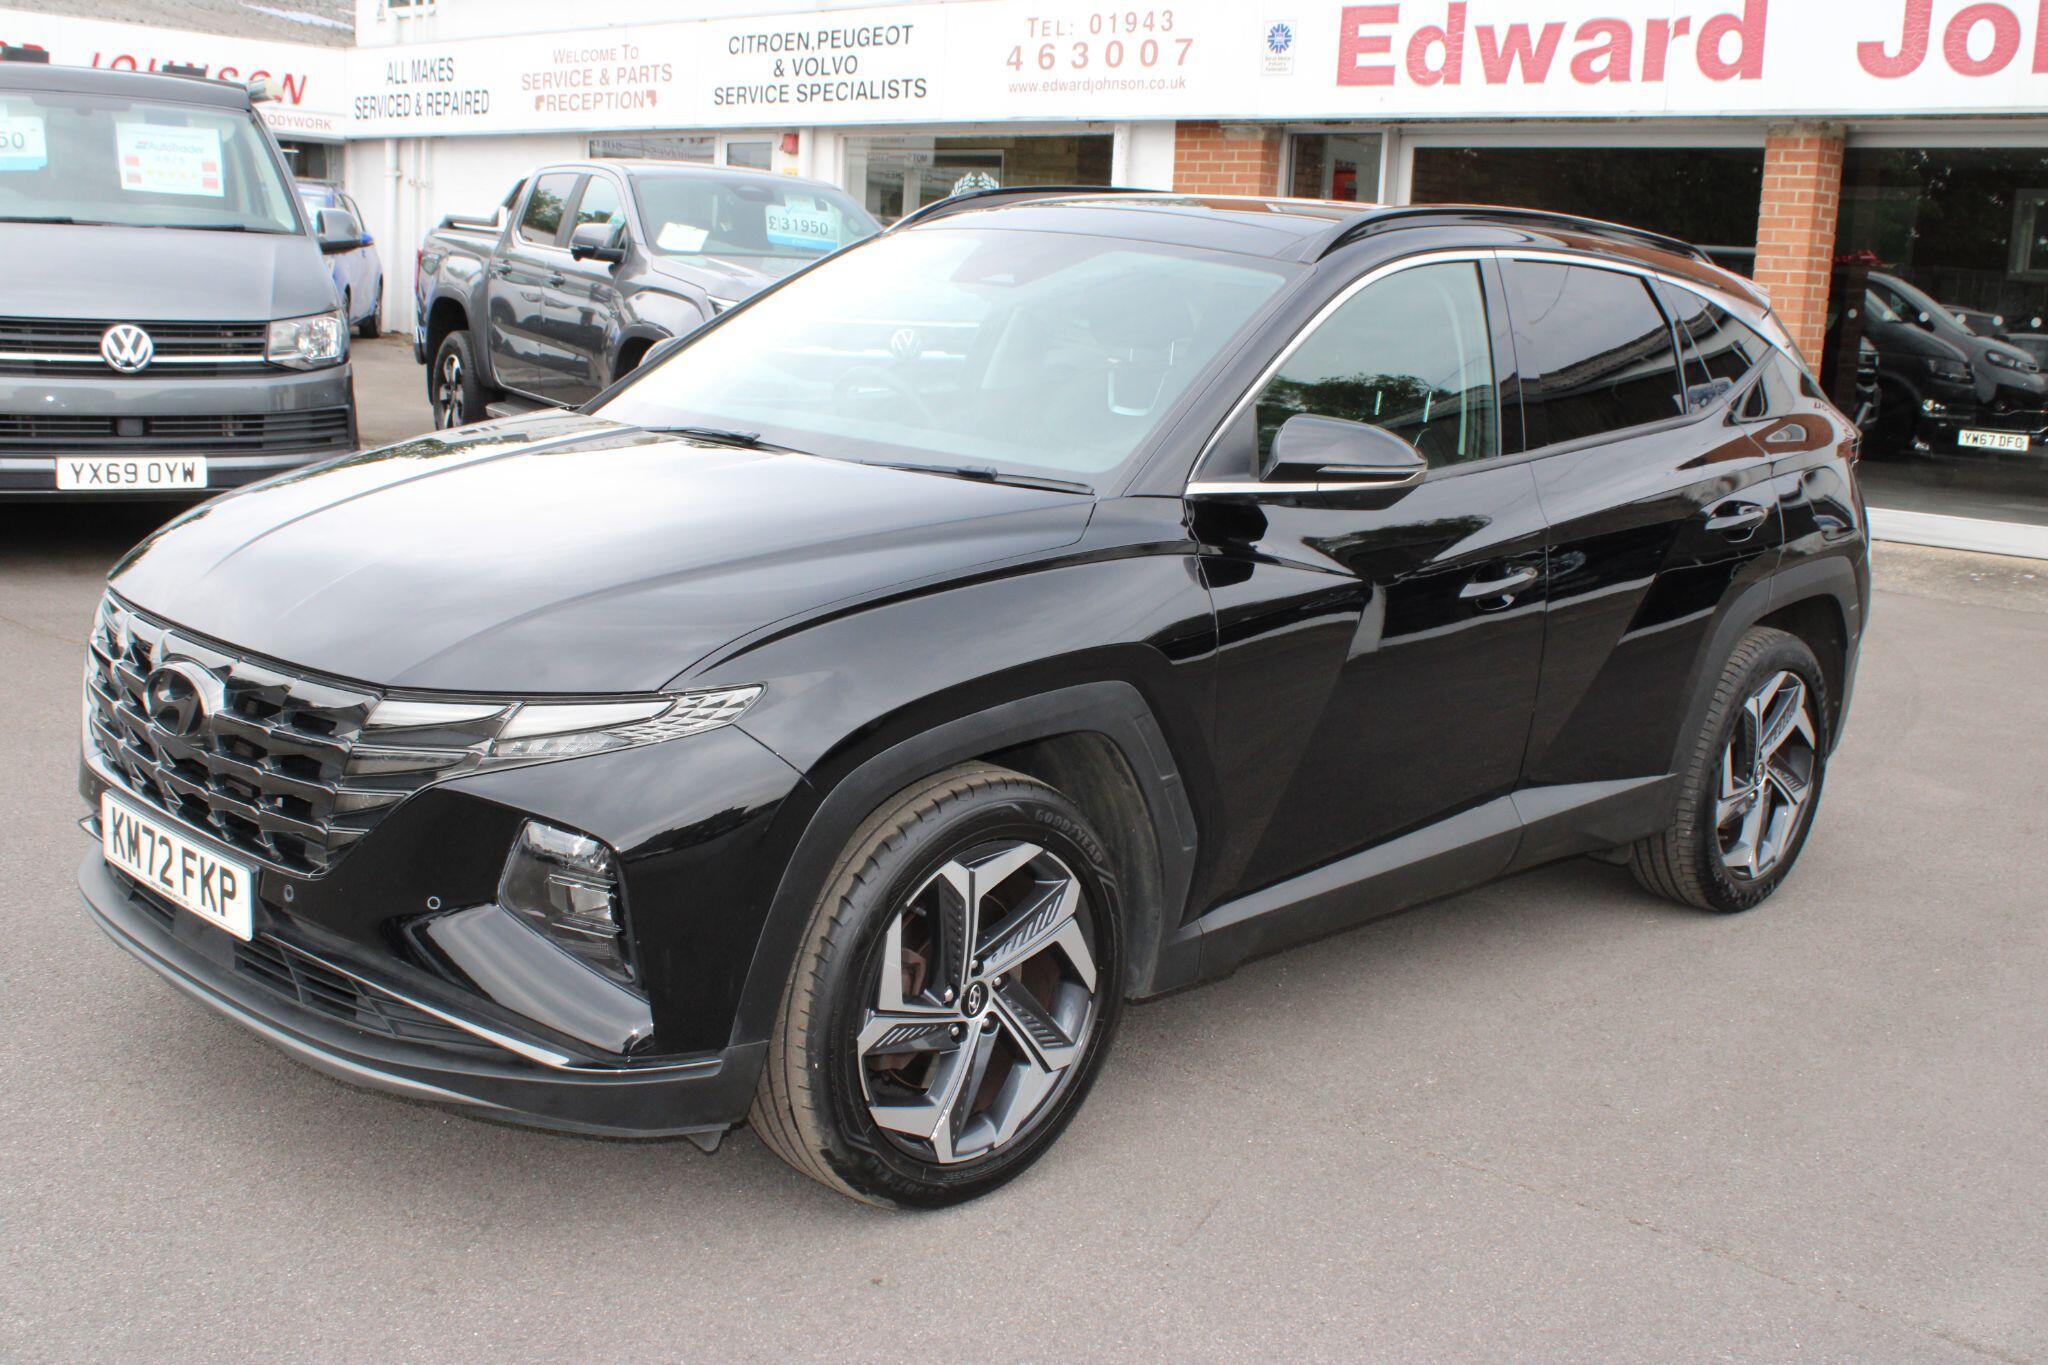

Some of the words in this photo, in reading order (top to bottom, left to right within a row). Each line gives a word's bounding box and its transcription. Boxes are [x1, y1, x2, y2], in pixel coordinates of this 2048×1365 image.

[1090, 9, 1173, 34] 01943
[1006, 38, 1194, 71] 463007
[1336, 0, 1768, 86] Edward
[1856, 0, 2048, 79] Jo
[387, 61, 407, 85] ALL
[411, 57, 455, 83] MAKES
[521, 69, 593, 91] SERVICE
[600, 68, 610, 86] &
[617, 63, 672, 85] PARTS
[773, 58, 785, 78] &
[792, 55, 858, 77] VOLVO
[714, 84, 790, 106] SERVICE
[796, 78, 928, 103] SPECIALISTS
[1008, 76, 1187, 96] www.edwardjohnson.co.uk
[354, 93, 412, 121] SERVICED
[415, 92, 423, 117] &
[426, 89, 490, 117] REPAIRED
[546, 90, 645, 112] RECEPTION
[70, 463, 138, 484] YX69
[147, 462, 195, 483] OYW
[112, 806, 174, 888] KM72
[181, 846, 237, 917] FKP
